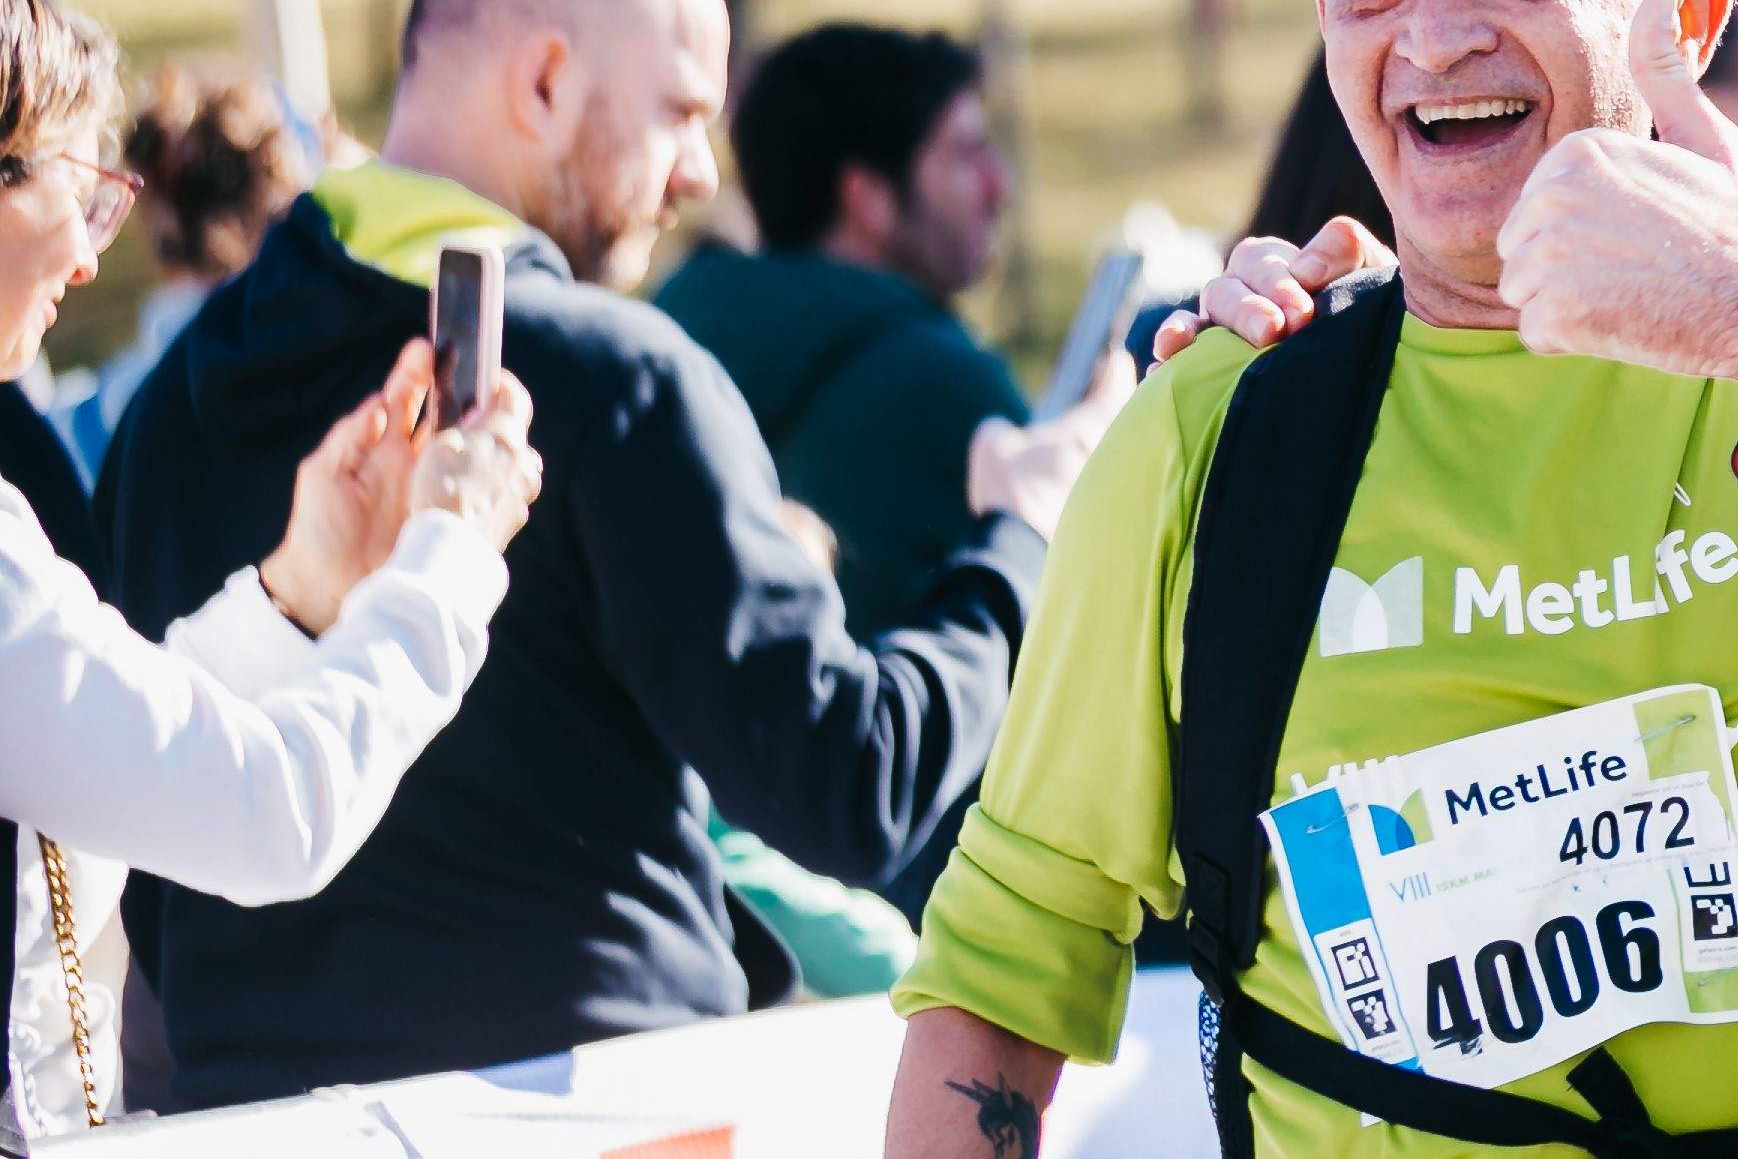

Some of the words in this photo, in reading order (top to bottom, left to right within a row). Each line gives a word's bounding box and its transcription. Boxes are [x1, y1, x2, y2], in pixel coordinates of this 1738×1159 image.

[1444, 750, 1628, 825] MetLife
[1559, 796, 1695, 866] 4072
[1389, 872, 1432, 902] VIII
[1426, 899, 1664, 1055] 4006
